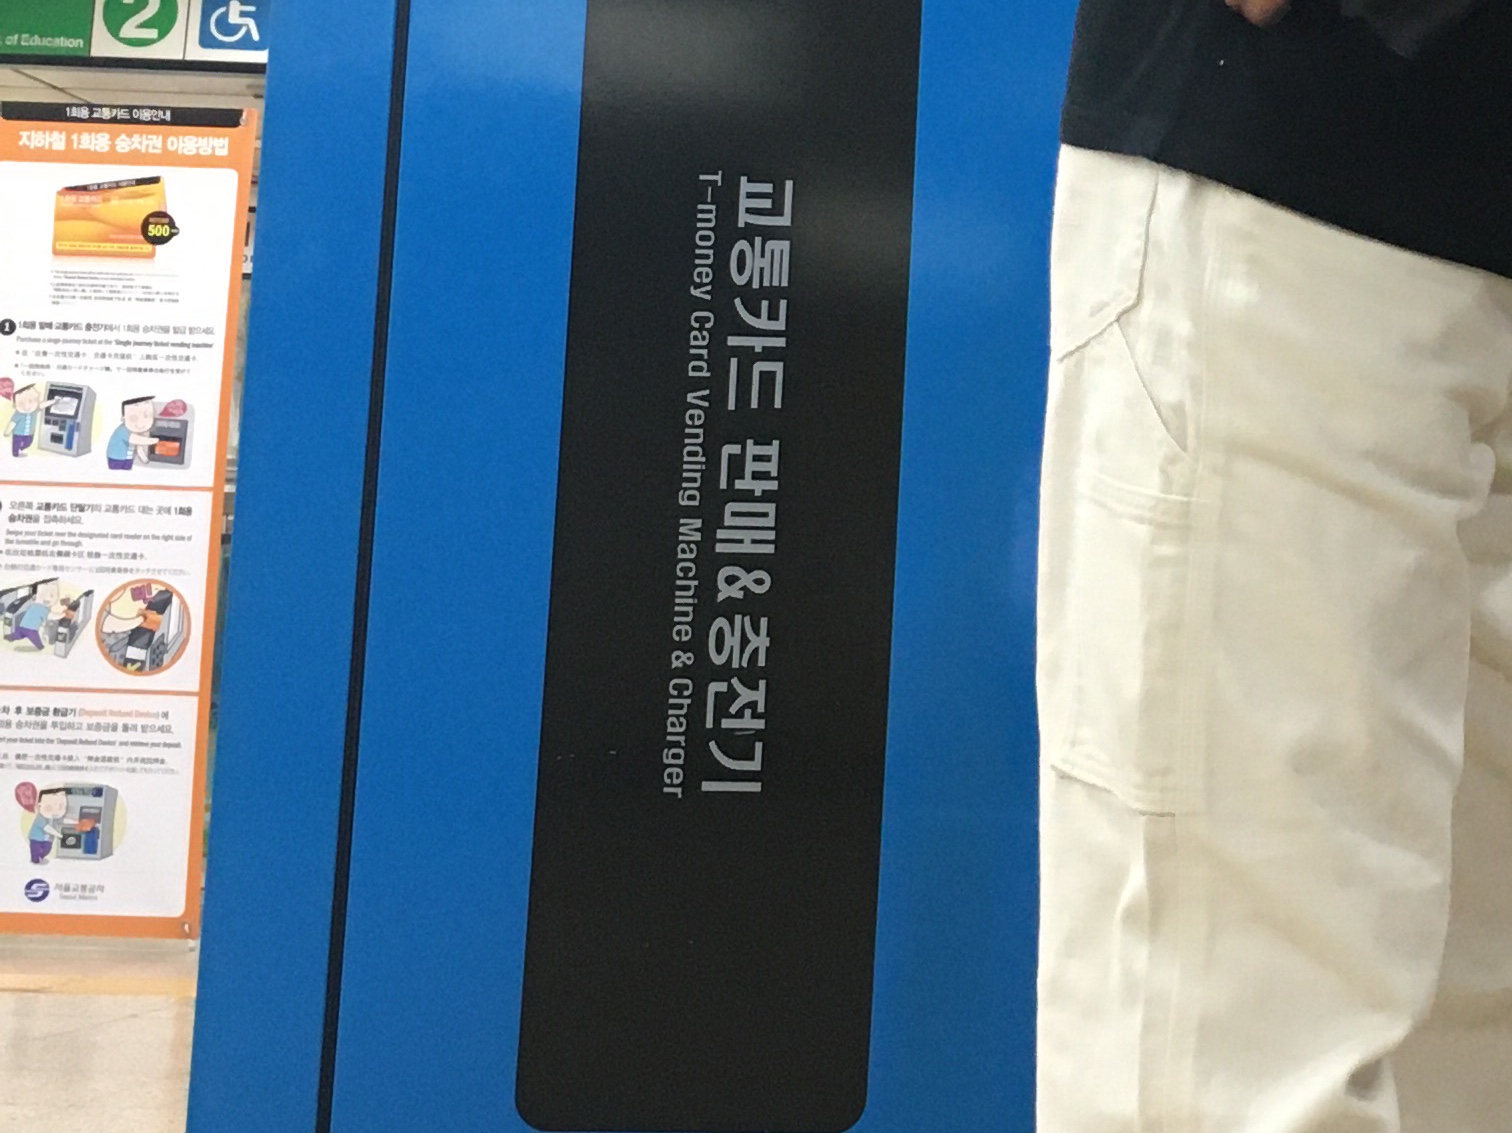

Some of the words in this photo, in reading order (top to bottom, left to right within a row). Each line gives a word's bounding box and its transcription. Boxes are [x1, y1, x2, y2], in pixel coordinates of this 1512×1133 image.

[5, 34, 18, 47] of
[21, 34, 84, 49] Education
[119, 0, 158, 39] 2
[65, 107, 89, 119] 1회용
[91, 108, 130, 121] 교통카드
[18, 130, 66, 150] 지하철
[71, 132, 110, 152] 1회용
[115, 133, 162, 153] 승차권
[167, 135, 229, 156] 이용방법
[147, 224, 170, 238] 500
[690, 170, 722, 300] T-money
[726, 175, 794, 411] 교통카드
[688, 310, 715, 377] Card
[678, 389, 710, 507] Vending
[672, 518, 702, 642] Machine
[671, 650, 694, 669] &
[662, 678, 693, 799] Charger
